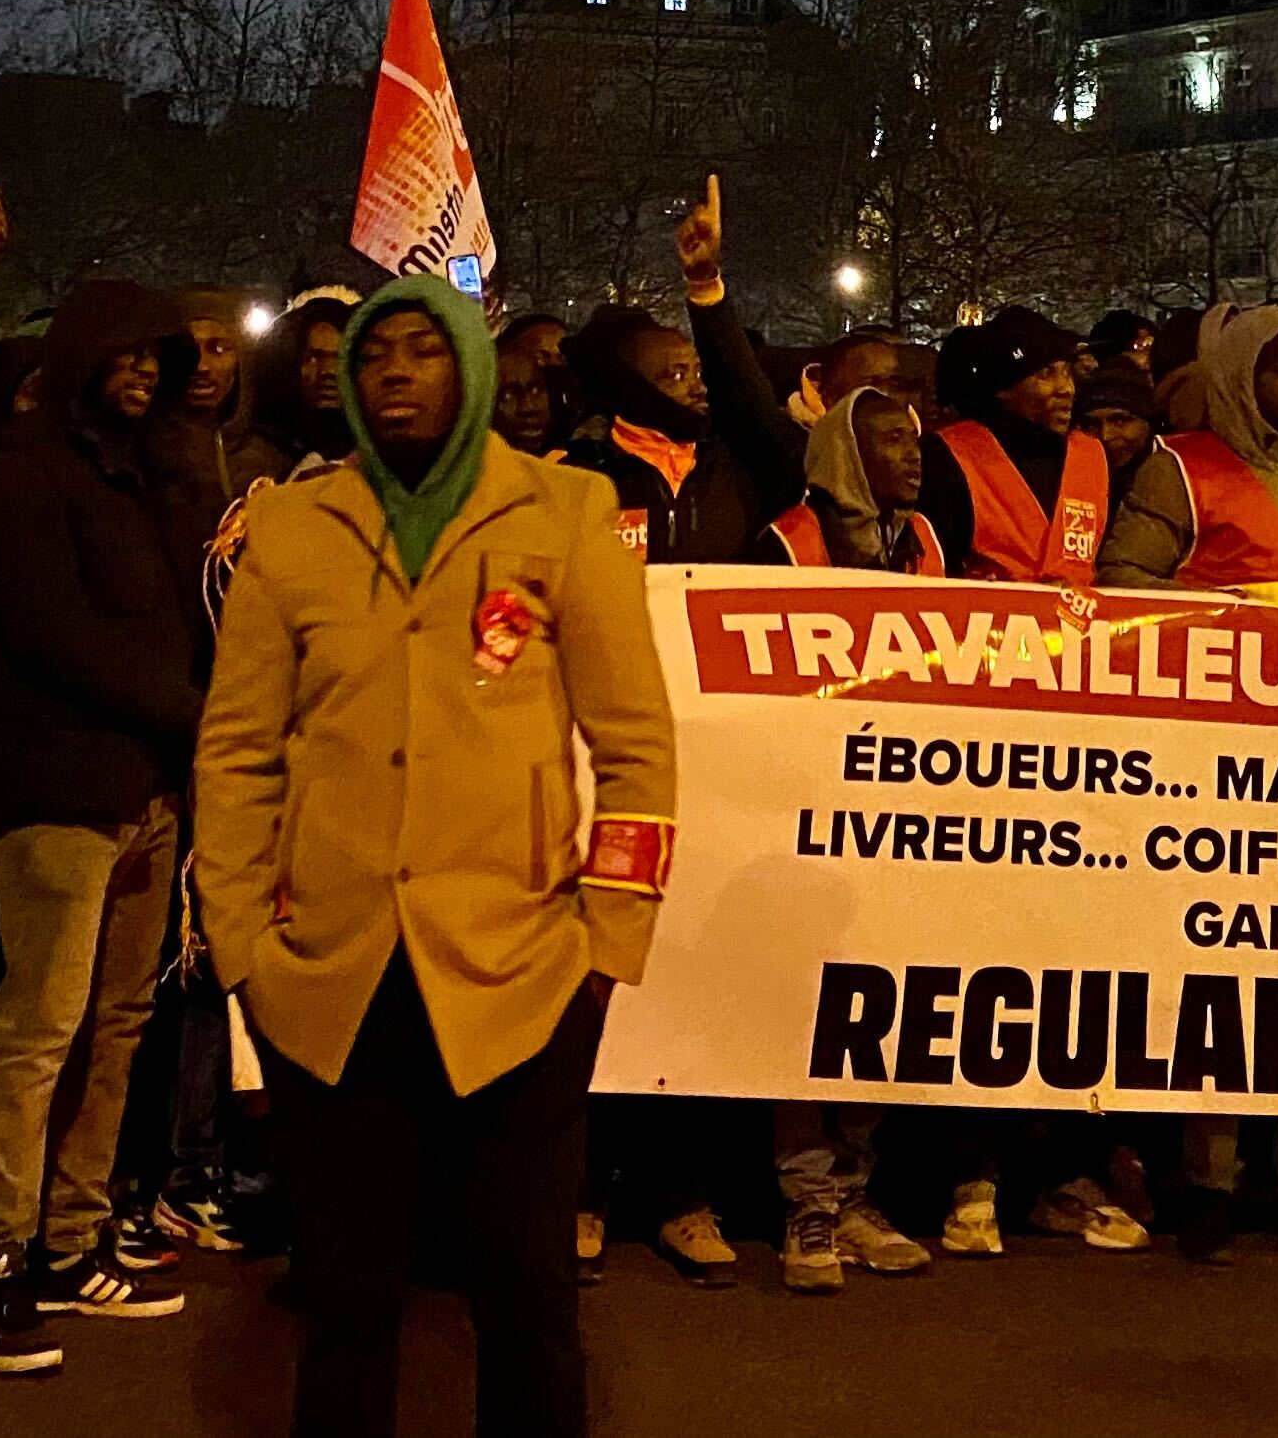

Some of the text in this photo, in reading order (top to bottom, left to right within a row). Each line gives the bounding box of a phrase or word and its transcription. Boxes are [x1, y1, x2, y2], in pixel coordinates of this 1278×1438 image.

[614, 523, 648, 549] gt
[1063, 530, 1095, 559] cgt
[1060, 588, 1098, 620] cgt
[842, 721, 1198, 800] ÉBOUEURS...
[796, 808, 1129, 871] LIVREURS...
